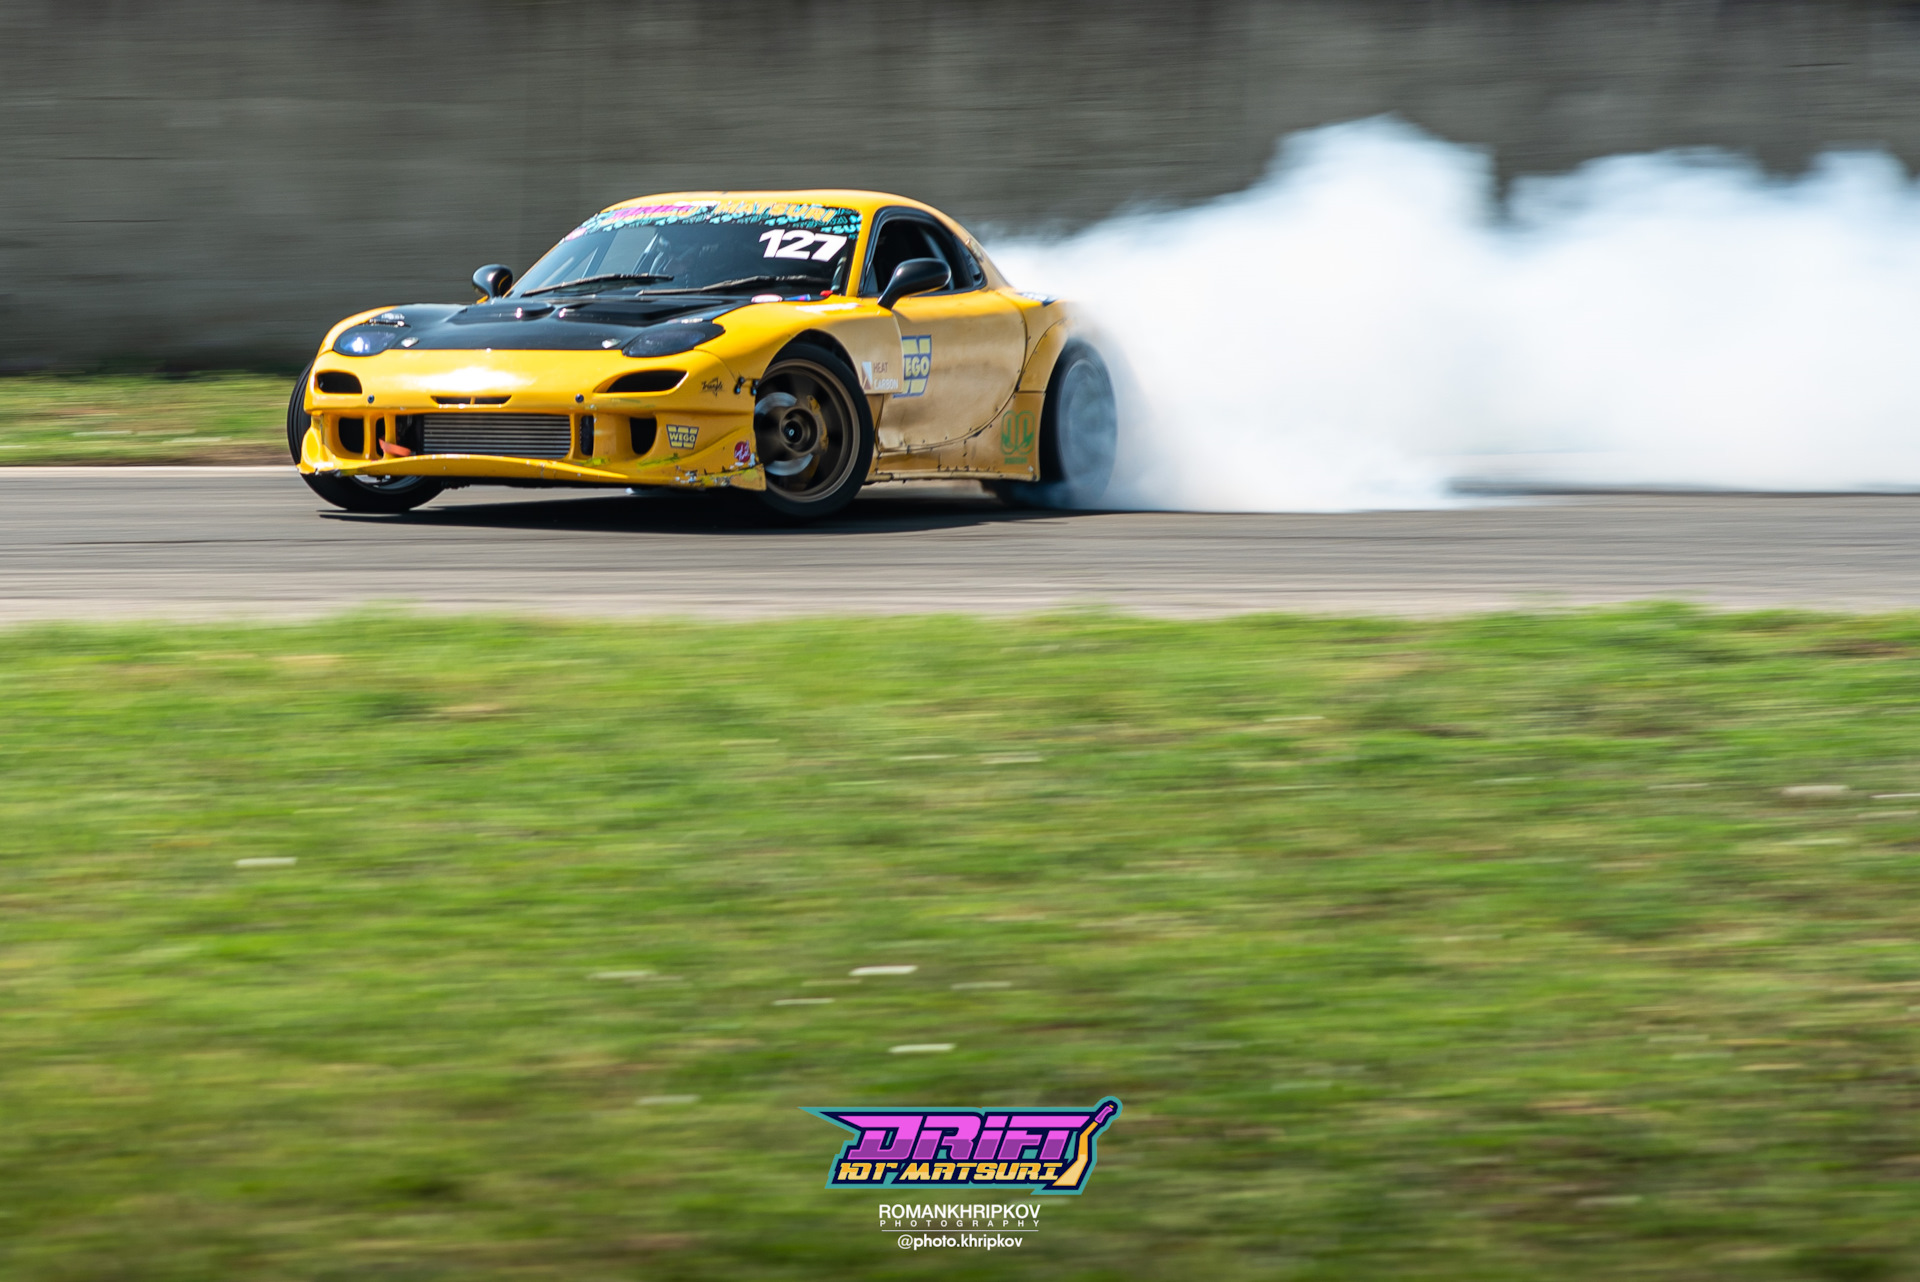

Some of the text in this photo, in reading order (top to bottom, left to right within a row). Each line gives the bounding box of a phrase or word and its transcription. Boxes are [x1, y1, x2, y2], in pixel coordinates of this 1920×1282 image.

[759, 229, 847, 262] 127
[874, 362, 888, 373] HEAT
[903, 357, 929, 377] EGO
[874, 378, 898, 390] CARBON
[669, 432, 695, 443] WEGO
